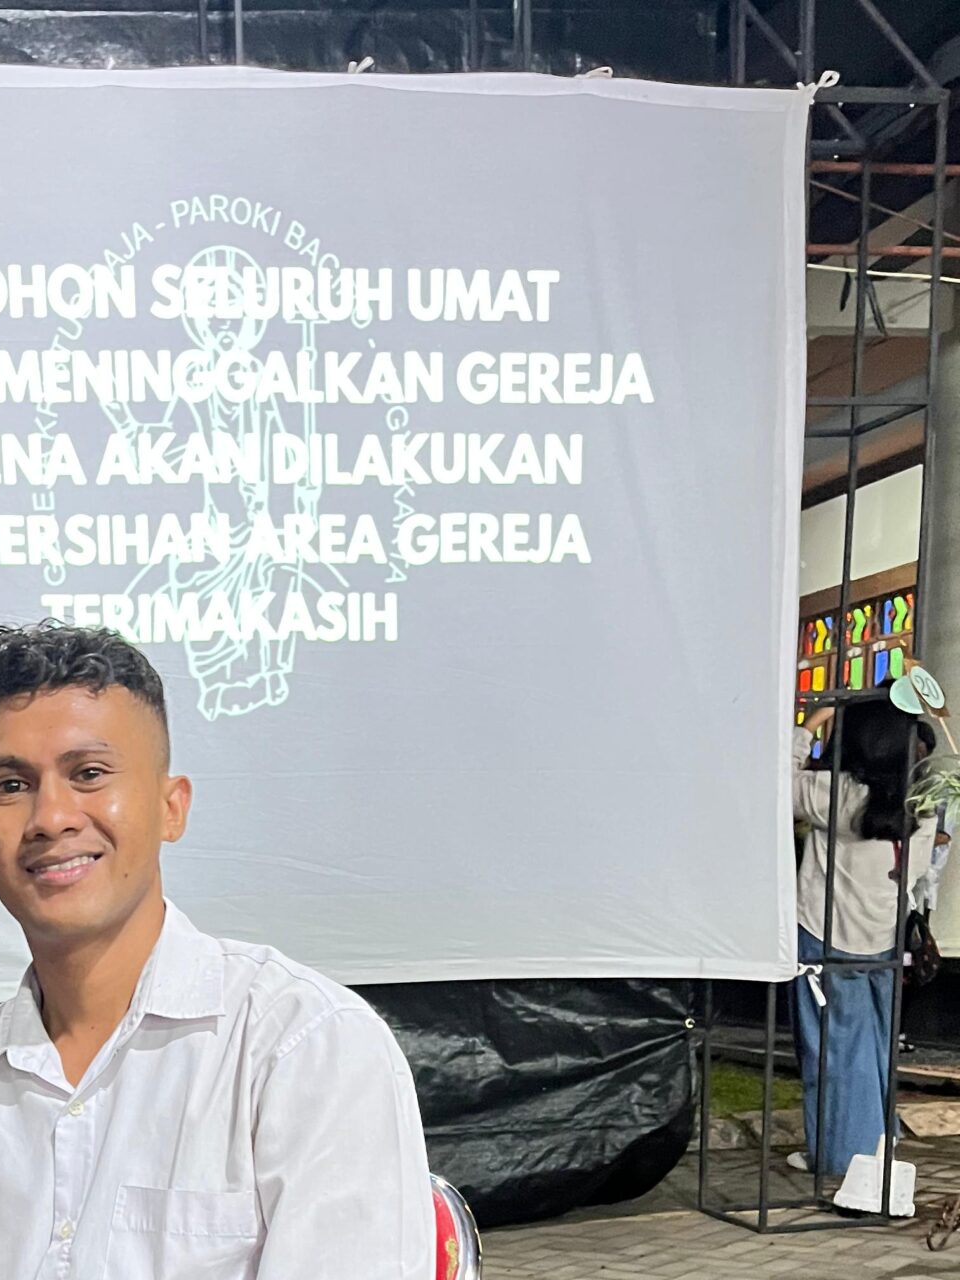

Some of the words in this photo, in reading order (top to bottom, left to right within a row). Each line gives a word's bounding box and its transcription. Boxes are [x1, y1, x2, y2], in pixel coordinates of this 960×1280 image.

[170, 194, 282, 237] PAROKI
[150, 263, 393, 321] SELURUH
[407, 268, 560, 322] UMAT
[456, 351, 654, 404] GEREJA
[97, 432, 257, 486] AKAN
[272, 432, 583, 486] DILAKUKAN
[248, 513, 387, 566] AREA
[394, 512, 591, 565] GEREJA
[41, 592, 399, 643] TERIMAKASIH
[913, 674, 940, 700] 20
